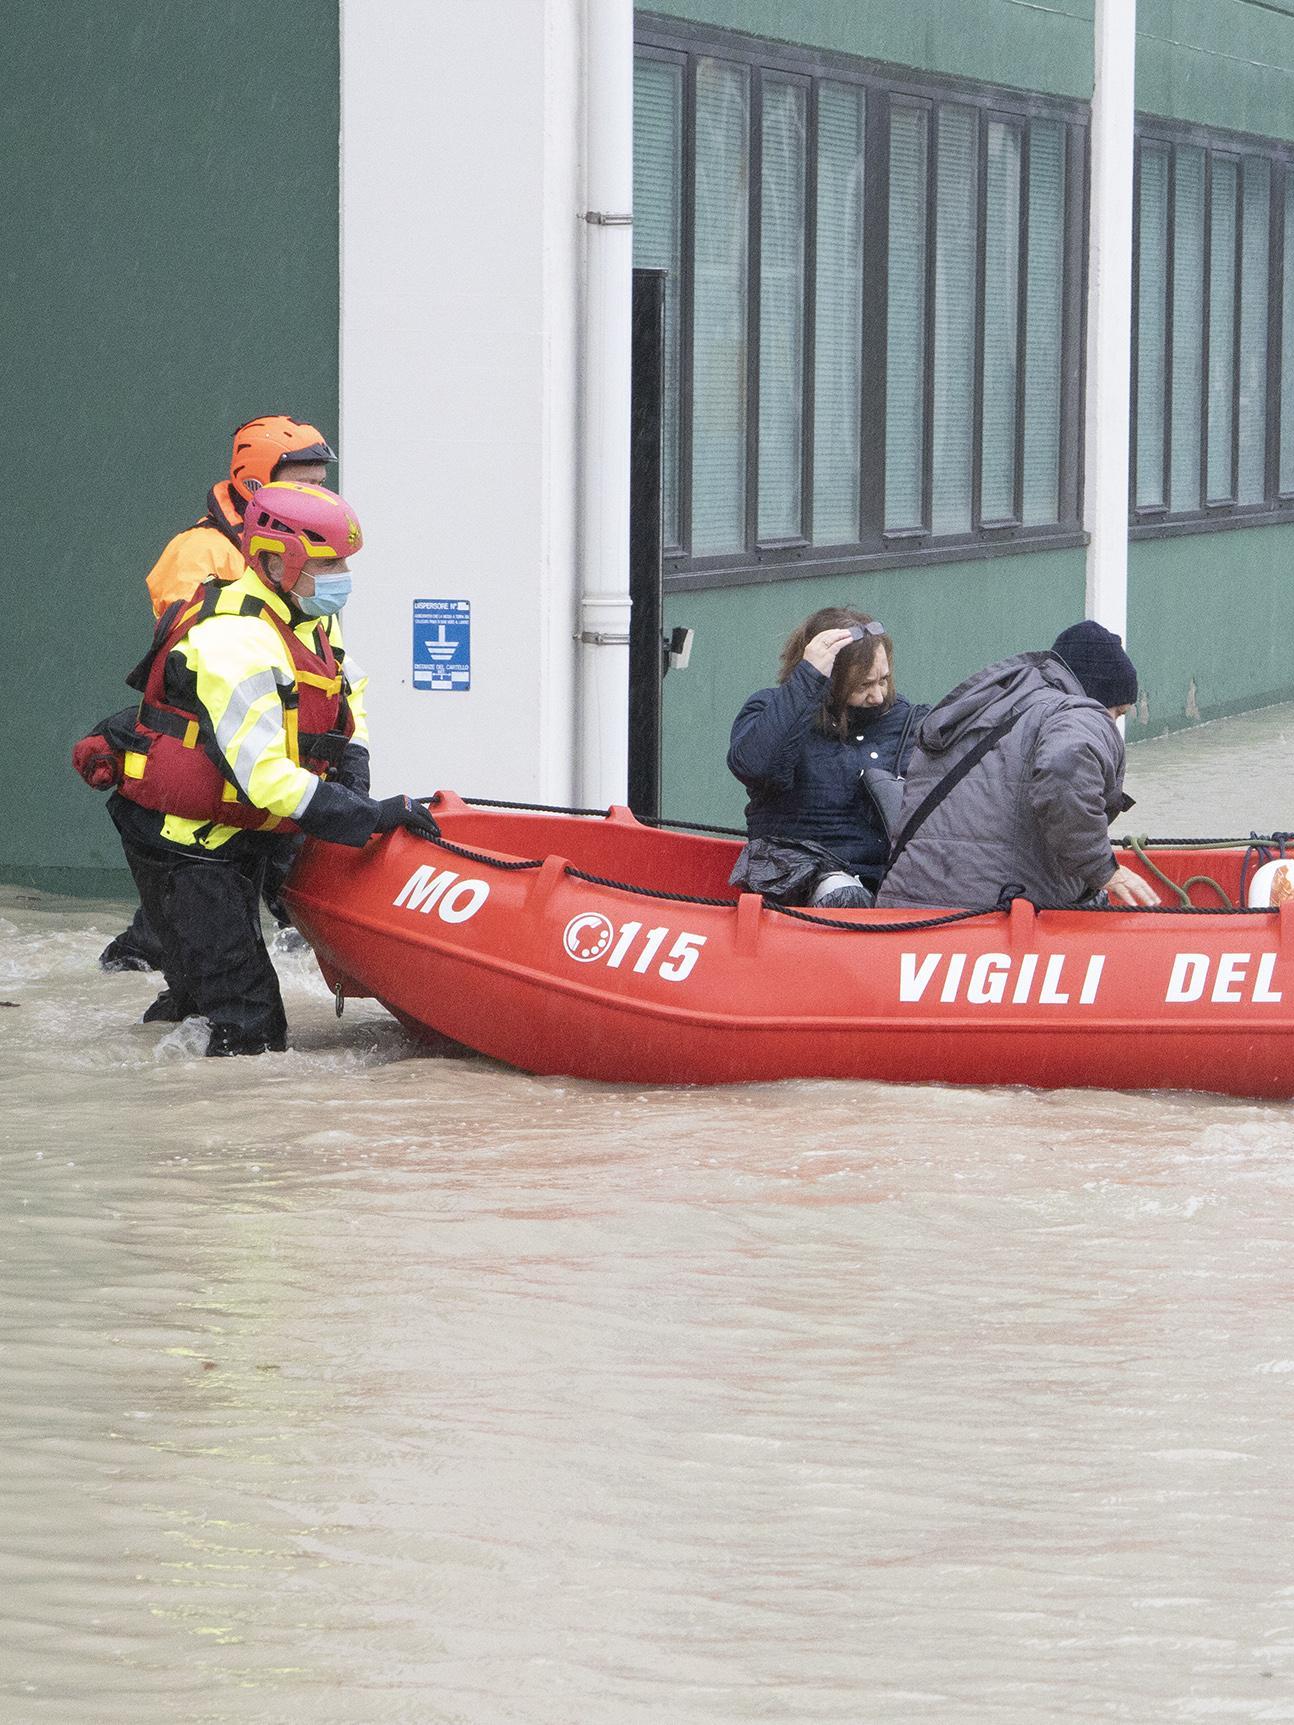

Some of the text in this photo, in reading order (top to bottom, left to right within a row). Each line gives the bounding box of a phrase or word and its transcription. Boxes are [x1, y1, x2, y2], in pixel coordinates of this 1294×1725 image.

[392, 864, 491, 924] MO
[606, 920, 708, 982] 115
[899, 952, 1106, 1005] VIGILI
[1164, 952, 1283, 1004] DEL
